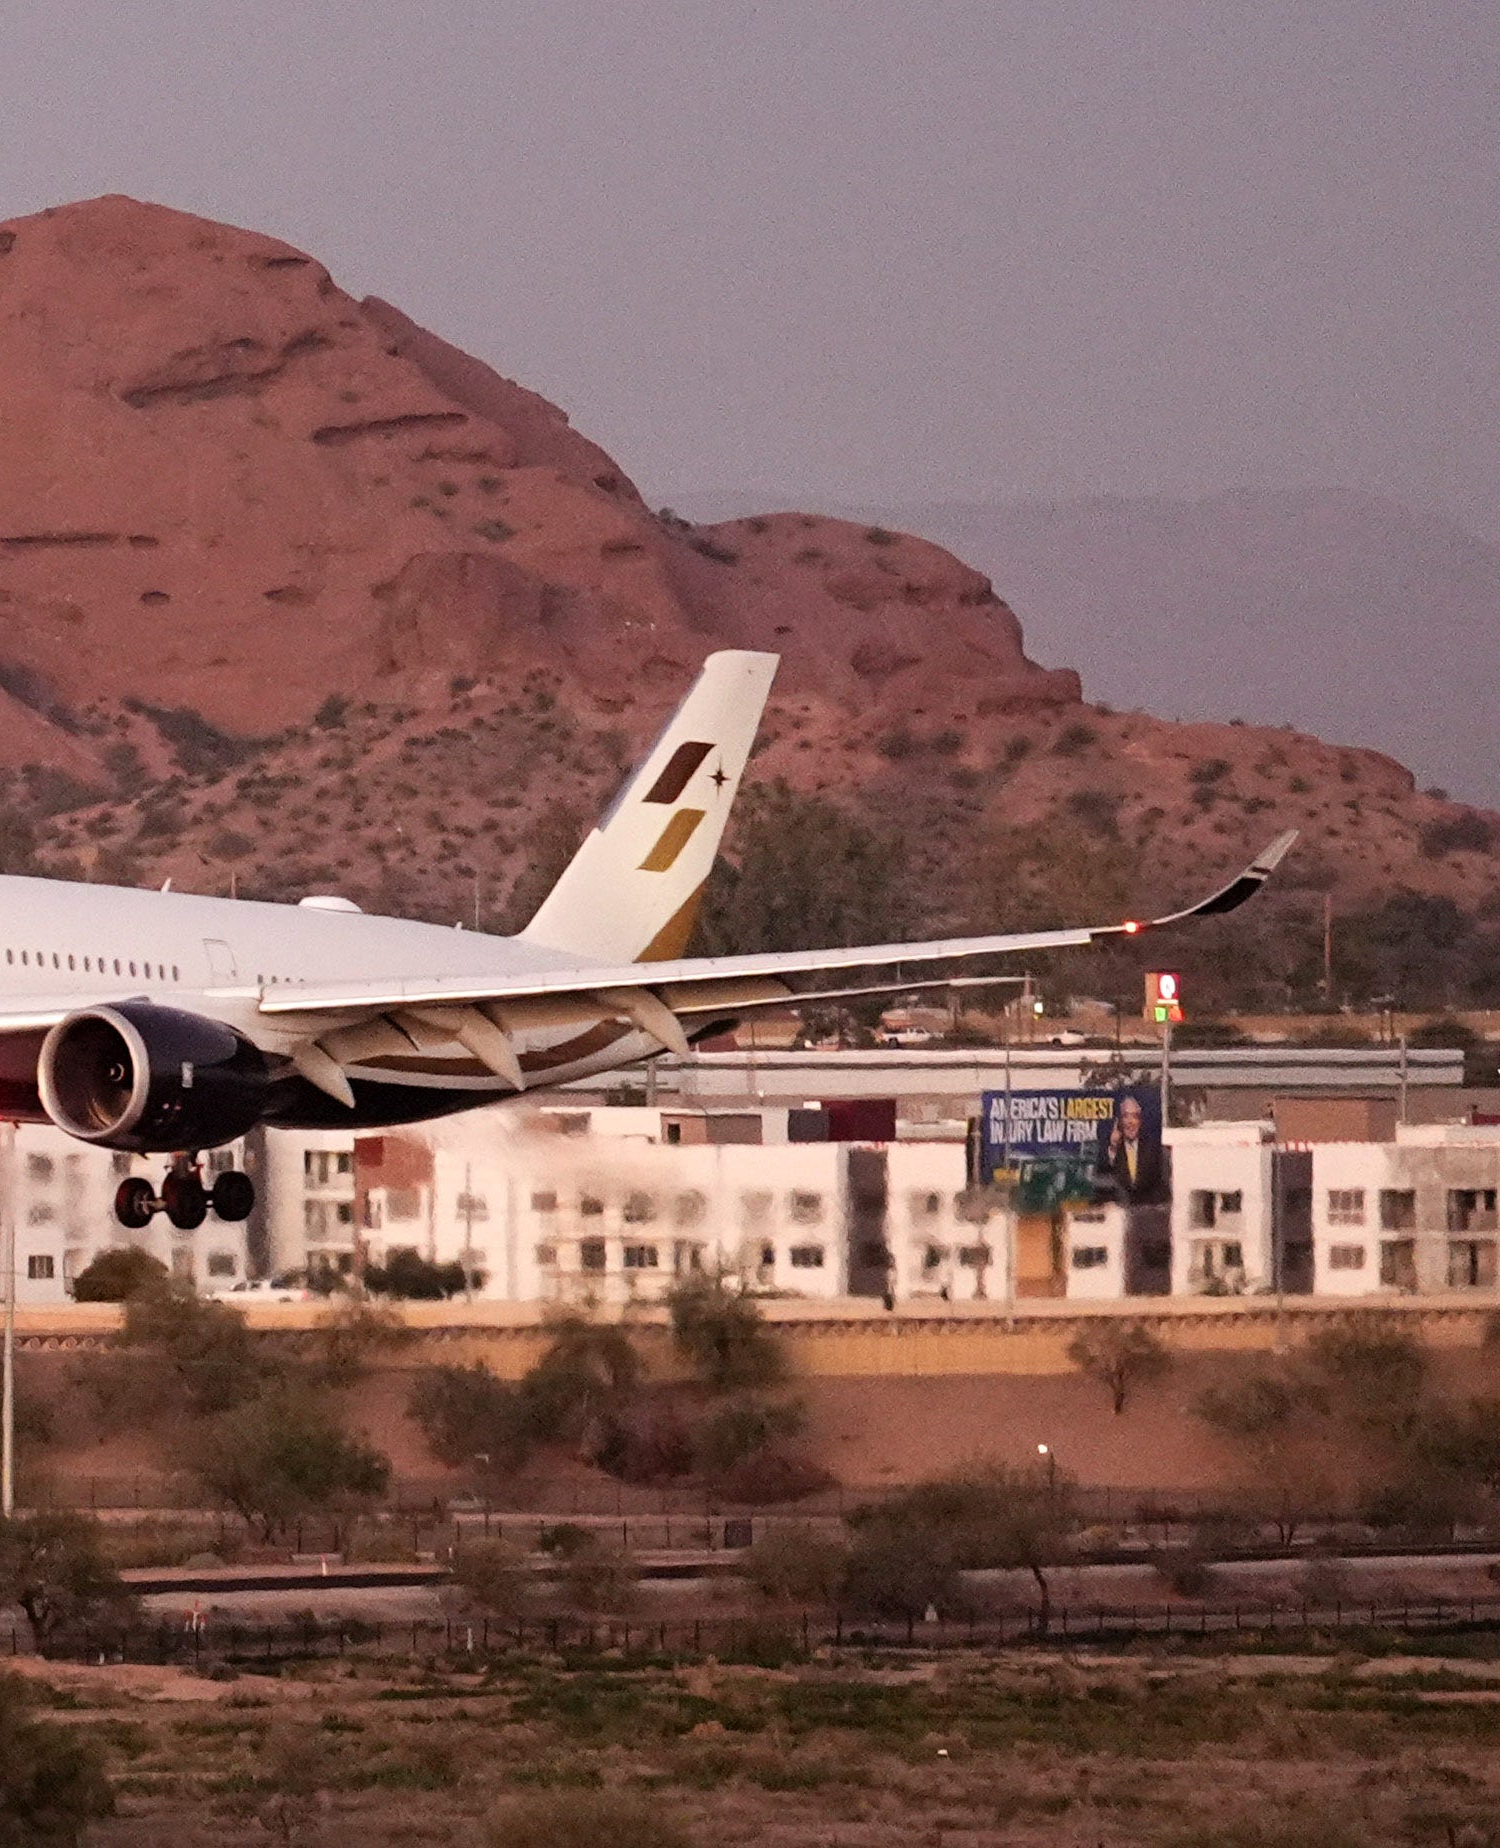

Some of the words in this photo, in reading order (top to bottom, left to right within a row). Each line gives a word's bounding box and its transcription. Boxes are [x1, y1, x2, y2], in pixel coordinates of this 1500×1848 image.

[1060, 1097, 1115, 1120] LARGEST
[1035, 1119, 1066, 1144] LAW
[1066, 1119, 1098, 1144] FIRM
